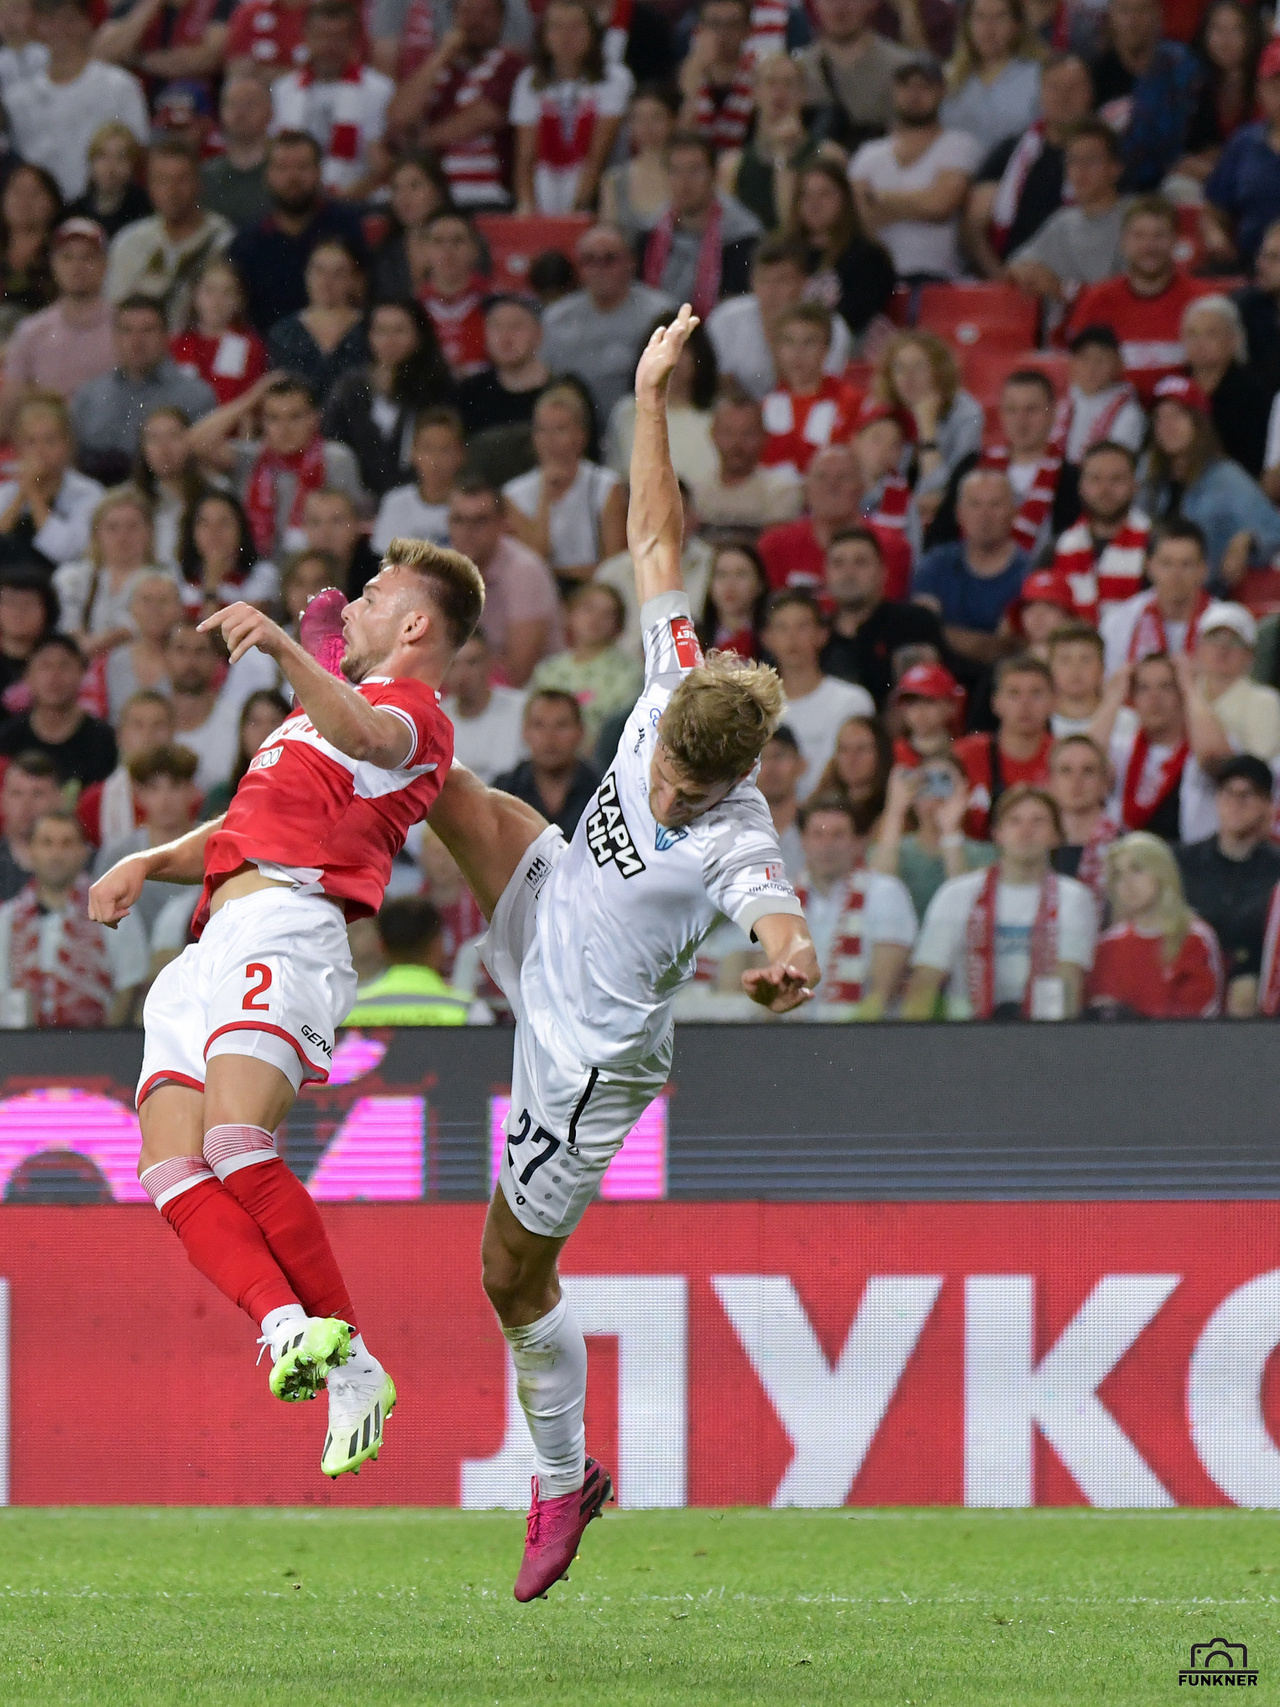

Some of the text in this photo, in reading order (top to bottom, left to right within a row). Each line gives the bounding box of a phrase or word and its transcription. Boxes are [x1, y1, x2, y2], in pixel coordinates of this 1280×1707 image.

[587, 811, 613, 864] НН
[599, 775, 643, 876] ПАРИ
[242, 962, 272, 1011] 2
[508, 1108, 561, 1186] 27
